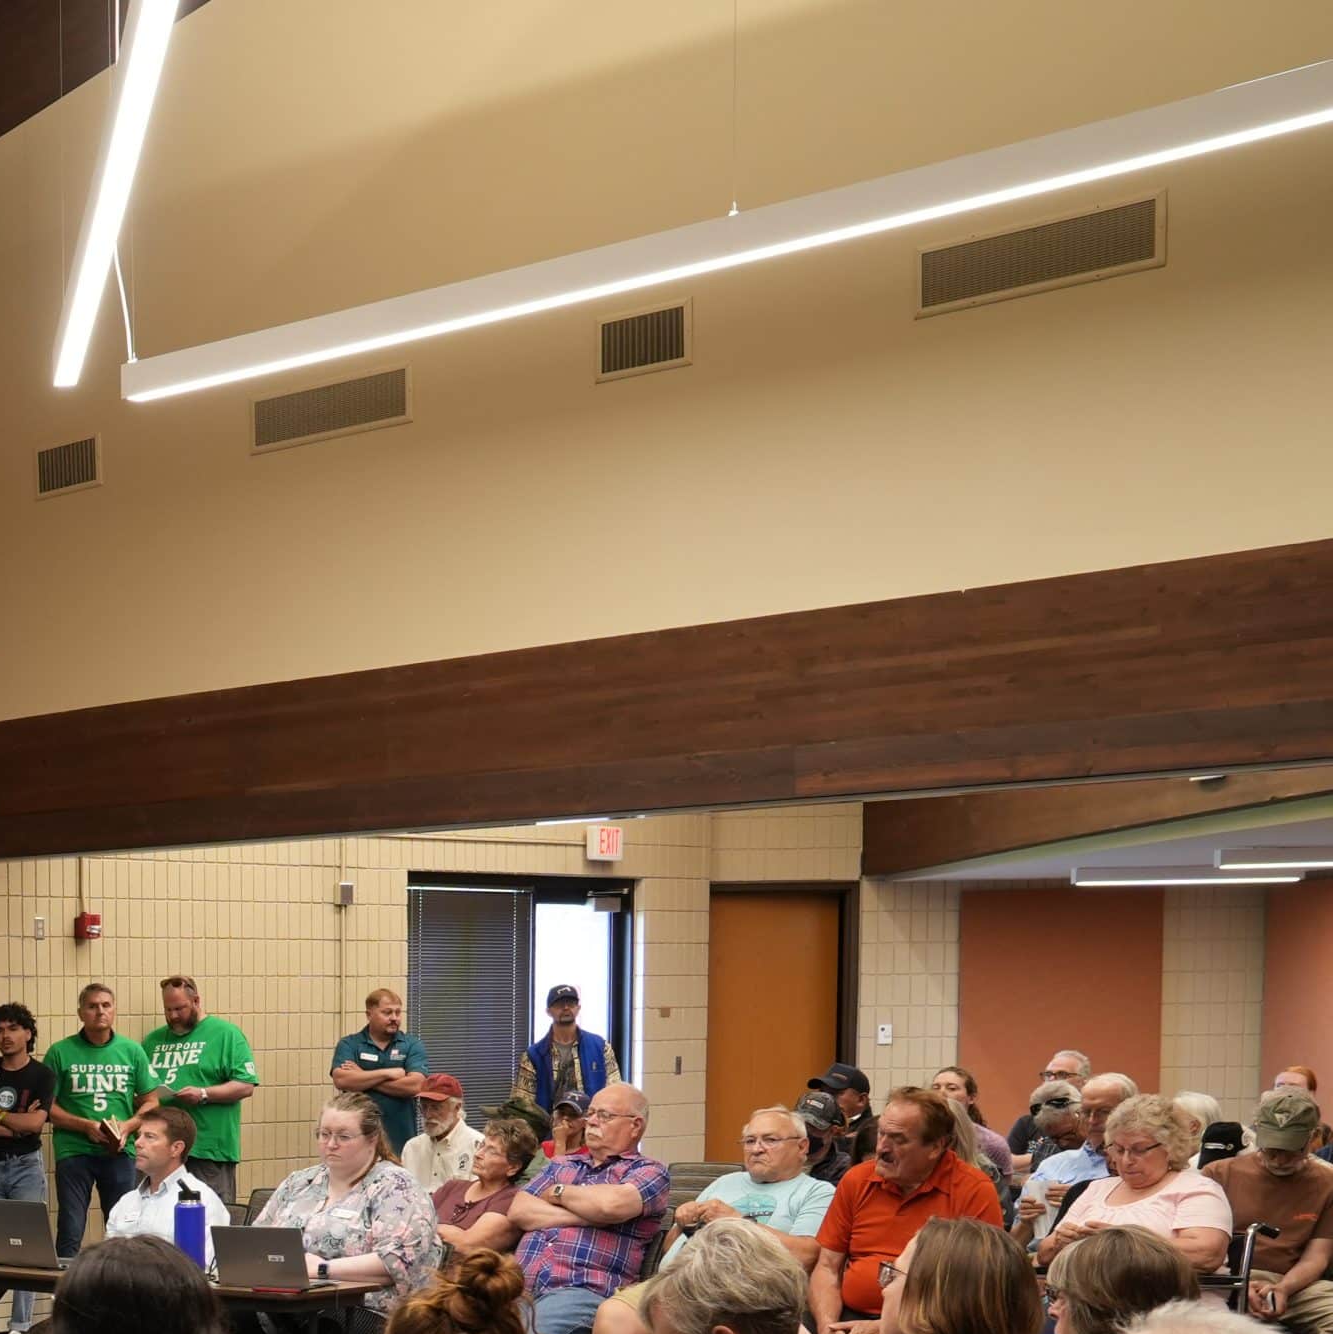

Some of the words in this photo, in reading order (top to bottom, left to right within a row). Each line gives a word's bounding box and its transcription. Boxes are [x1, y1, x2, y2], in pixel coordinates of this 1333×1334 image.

[599, 828, 621, 855] EXIT
[155, 1041, 206, 1052] SUPPORT
[152, 1049, 202, 1069] LINE
[71, 1064, 130, 1073] SUPPORT
[165, 1068, 178, 1084] 5
[71, 1073, 129, 1093] LINE
[93, 1093, 108, 1111] 5
